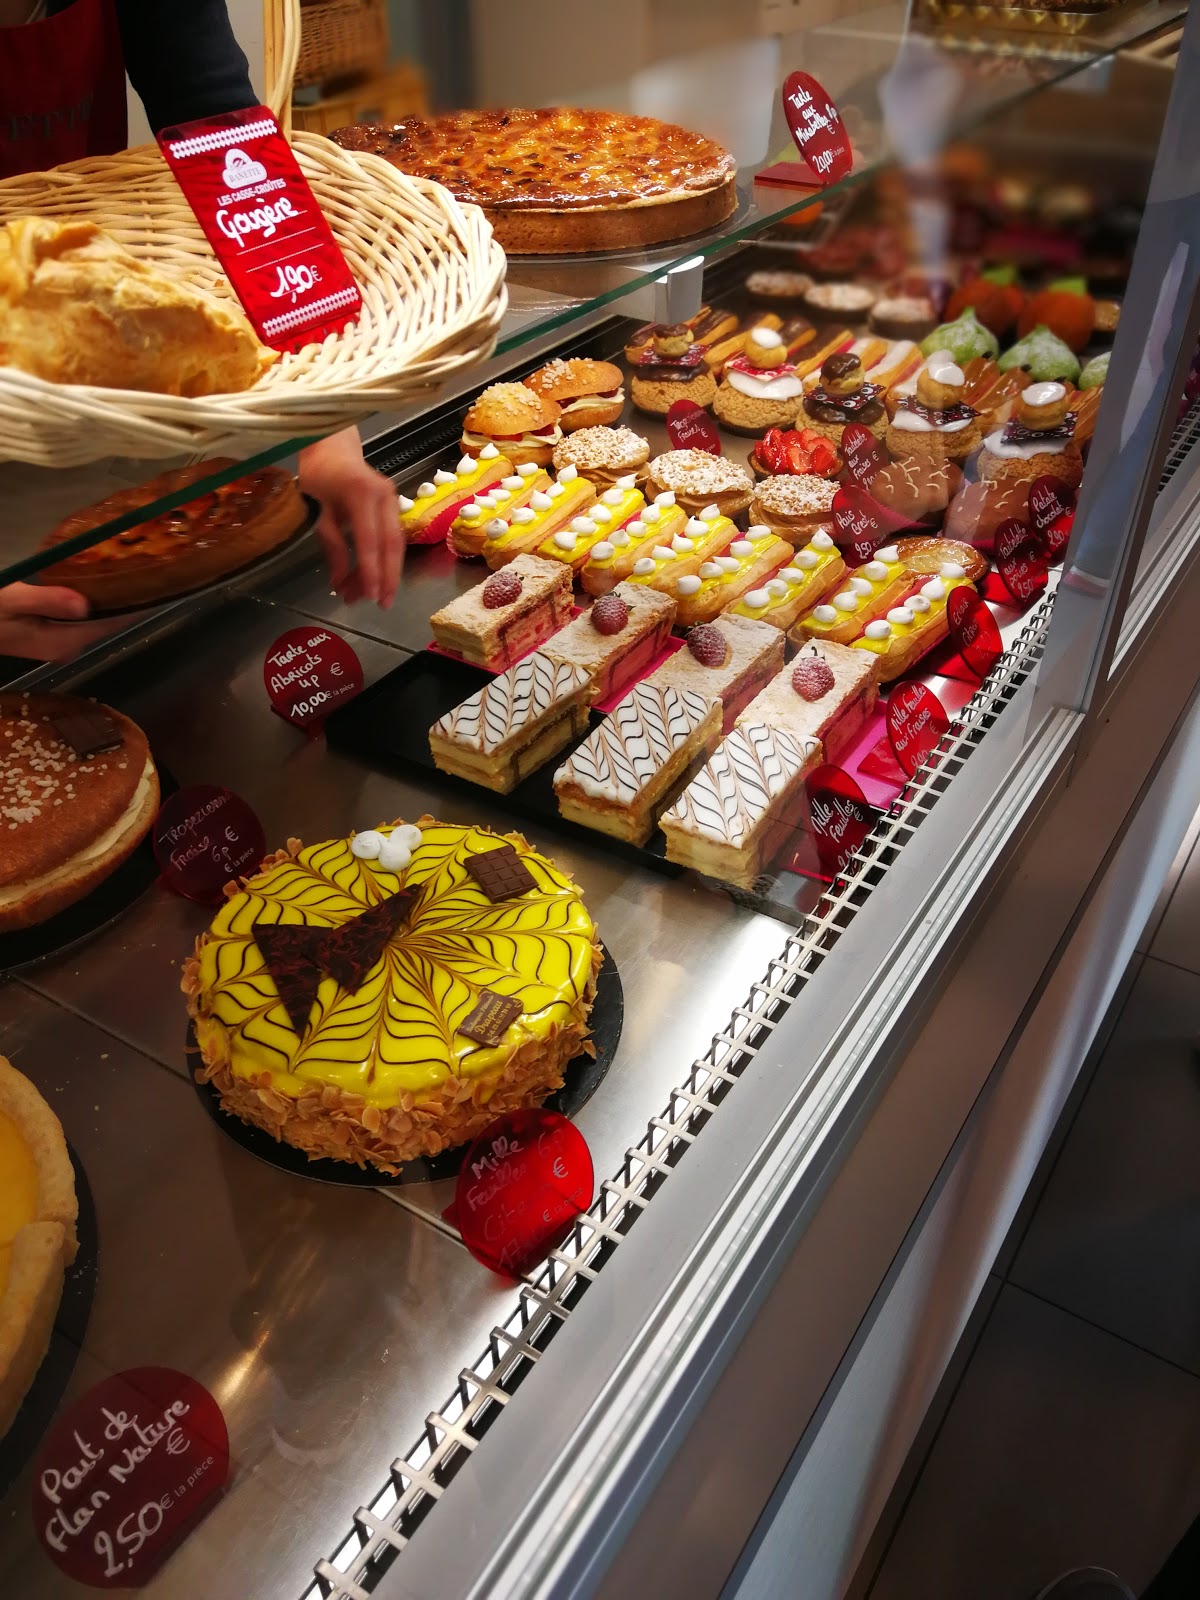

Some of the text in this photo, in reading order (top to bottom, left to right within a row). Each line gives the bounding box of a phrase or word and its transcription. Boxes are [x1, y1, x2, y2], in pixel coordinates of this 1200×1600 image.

[802, 104, 817, 120] aux
[217, 178, 287, 206] LES CASSE-CROÛTES
[216, 197, 299, 248] Gougère
[848, 455, 859, 468] aux
[1004, 558, 1016, 575] aux
[267, 633, 331, 667] Tarte aux
[271, 653, 322, 693] Abricots
[330, 662, 344, 676] €
[895, 733, 909, 751] aux
[225, 826, 239, 841] €
[471, 1135, 525, 1180] Mille
[553, 1156, 569, 1178] €
[101, 1407, 139, 1440] de
[166, 1427, 191, 1456] €
[45, 1400, 191, 1553] Flan Nature
[174, 1484, 187, 1497] la
[186, 1456, 215, 1487] pièce
